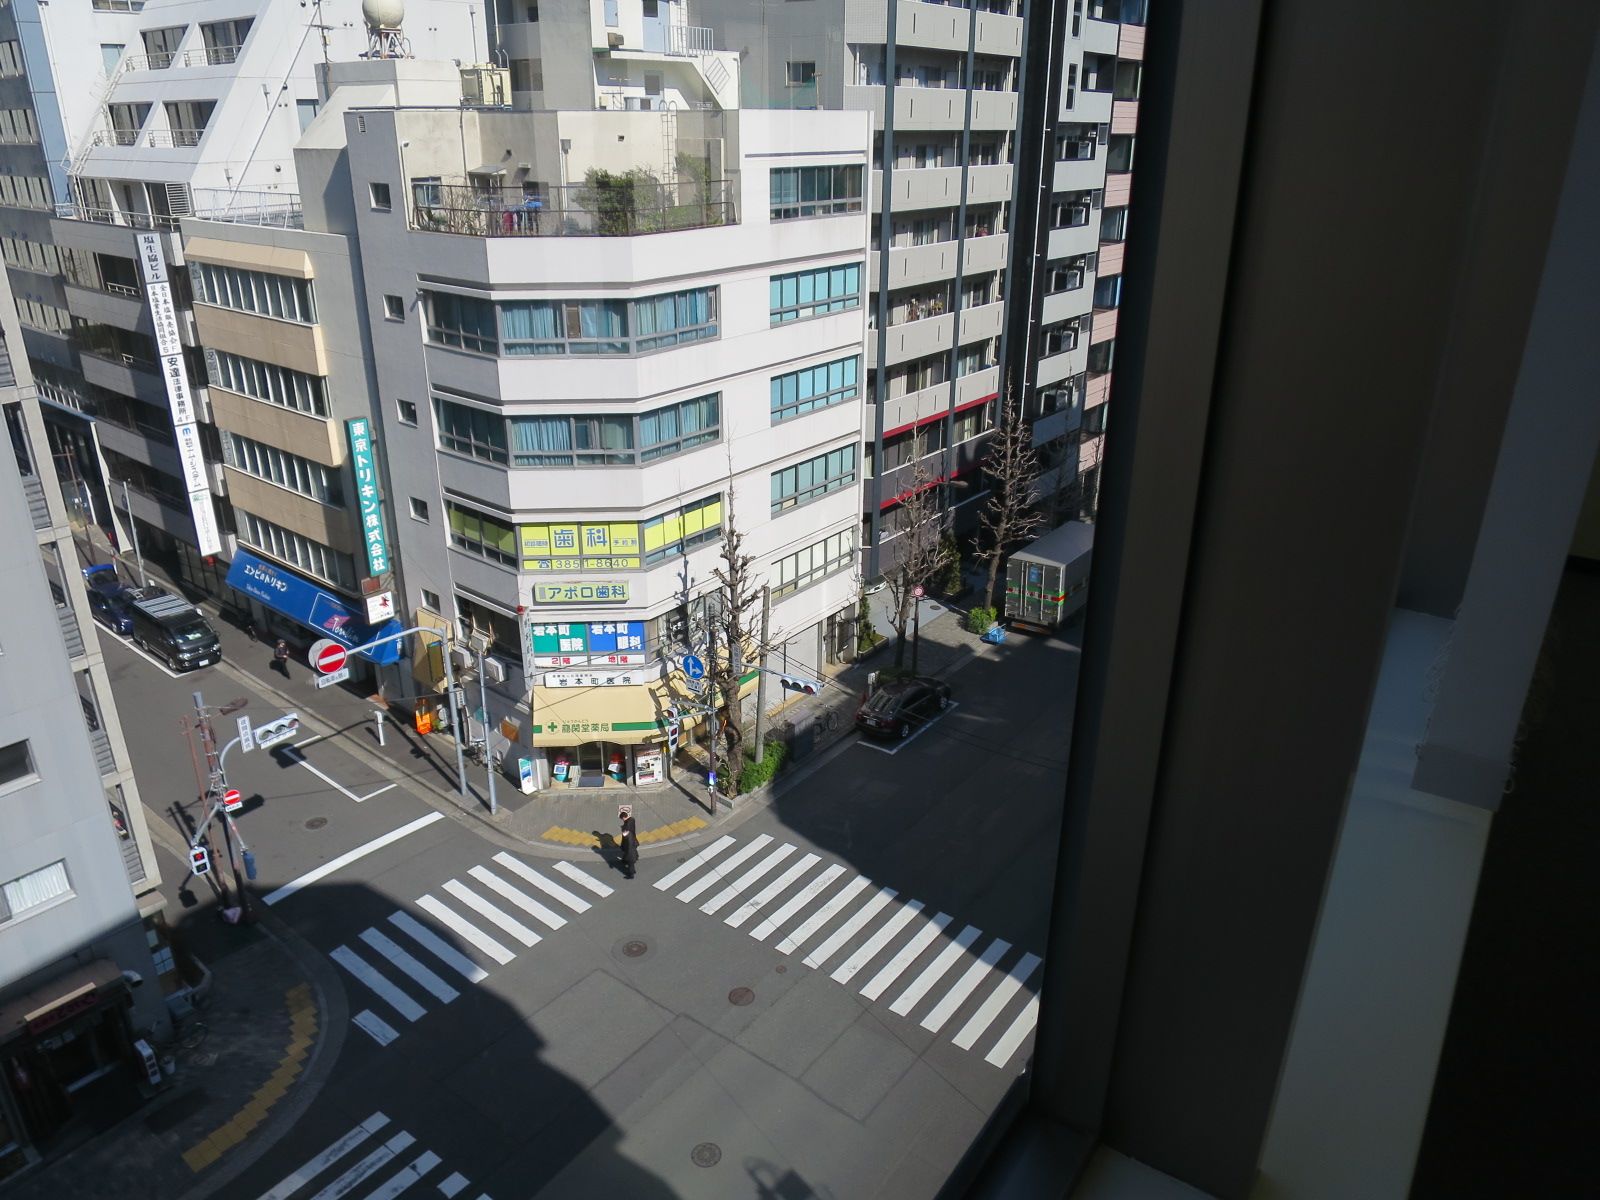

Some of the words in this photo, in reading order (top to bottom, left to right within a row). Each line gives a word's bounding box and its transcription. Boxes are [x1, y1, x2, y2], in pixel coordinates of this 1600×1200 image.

[143, 236, 161, 280] 塩生協ビル
[352, 423, 385, 571] 東京トリキン株式会社
[556, 558, 628, 569] 3851-8640
[548, 585, 625, 599] アポロ歯科
[533, 624, 570, 636] 岩本町
[591, 623, 629, 635] 岩本町
[559, 638, 584, 651] 医院
[617, 636, 642, 650] 眼科
[608, 656, 629, 664] 地階
[559, 677, 631, 686] 岩本町医院
